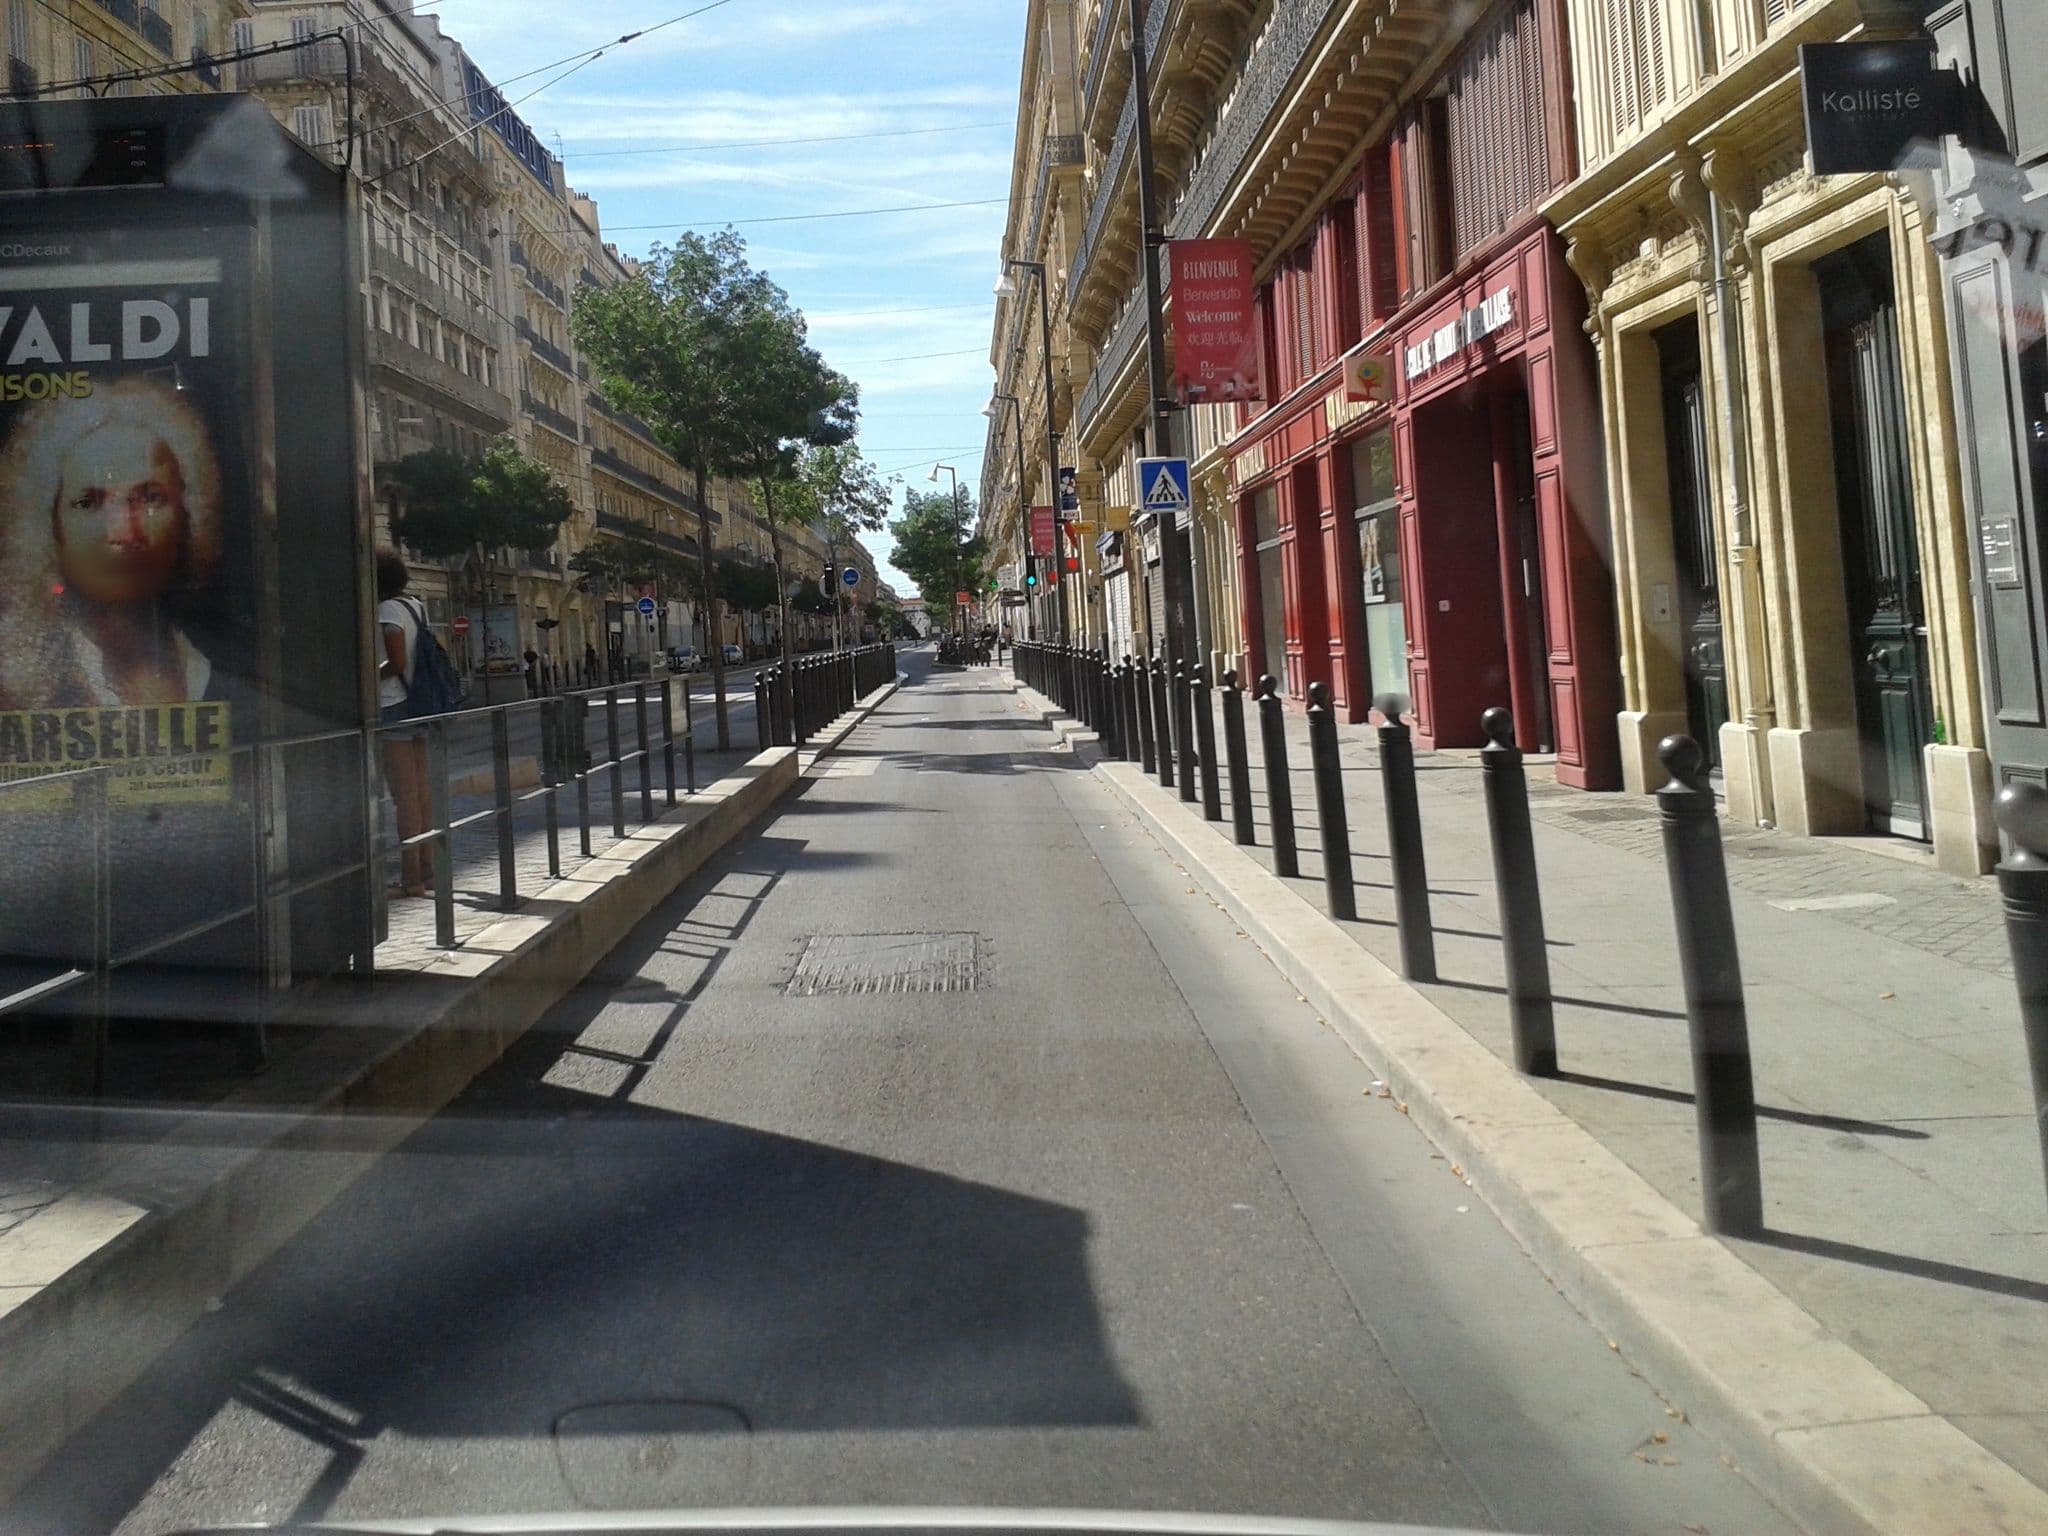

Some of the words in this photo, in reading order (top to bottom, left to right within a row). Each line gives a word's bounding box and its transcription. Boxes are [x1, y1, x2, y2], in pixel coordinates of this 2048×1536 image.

[1822, 88, 1921, 112] Kallisté
[1183, 259, 1239, 281] BIENVENUE
[1183, 287, 1241, 302] Benvenuto
[1185, 309, 1243, 324] Welcome
[0, 297, 210, 366] ALDI
